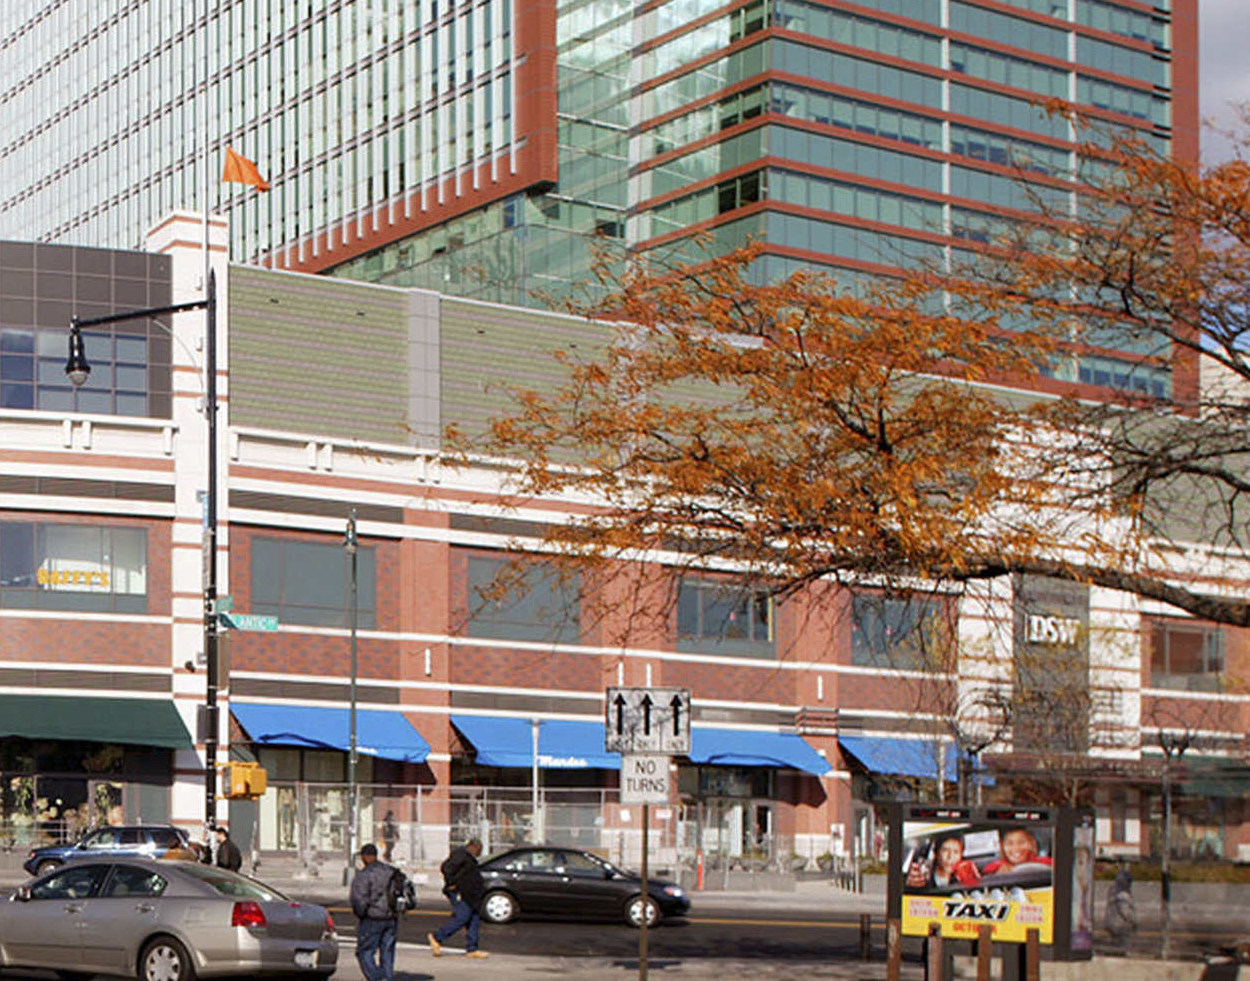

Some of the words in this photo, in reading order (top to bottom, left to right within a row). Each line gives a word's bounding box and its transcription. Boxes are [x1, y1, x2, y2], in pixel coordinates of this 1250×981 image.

[37, 567, 109, 586] DAFFY'S
[1030, 616, 1081, 644] DSW
[635, 761, 656, 775] NO
[626, 778, 666, 793] TURNS
[945, 902, 1010, 921] TAXI
